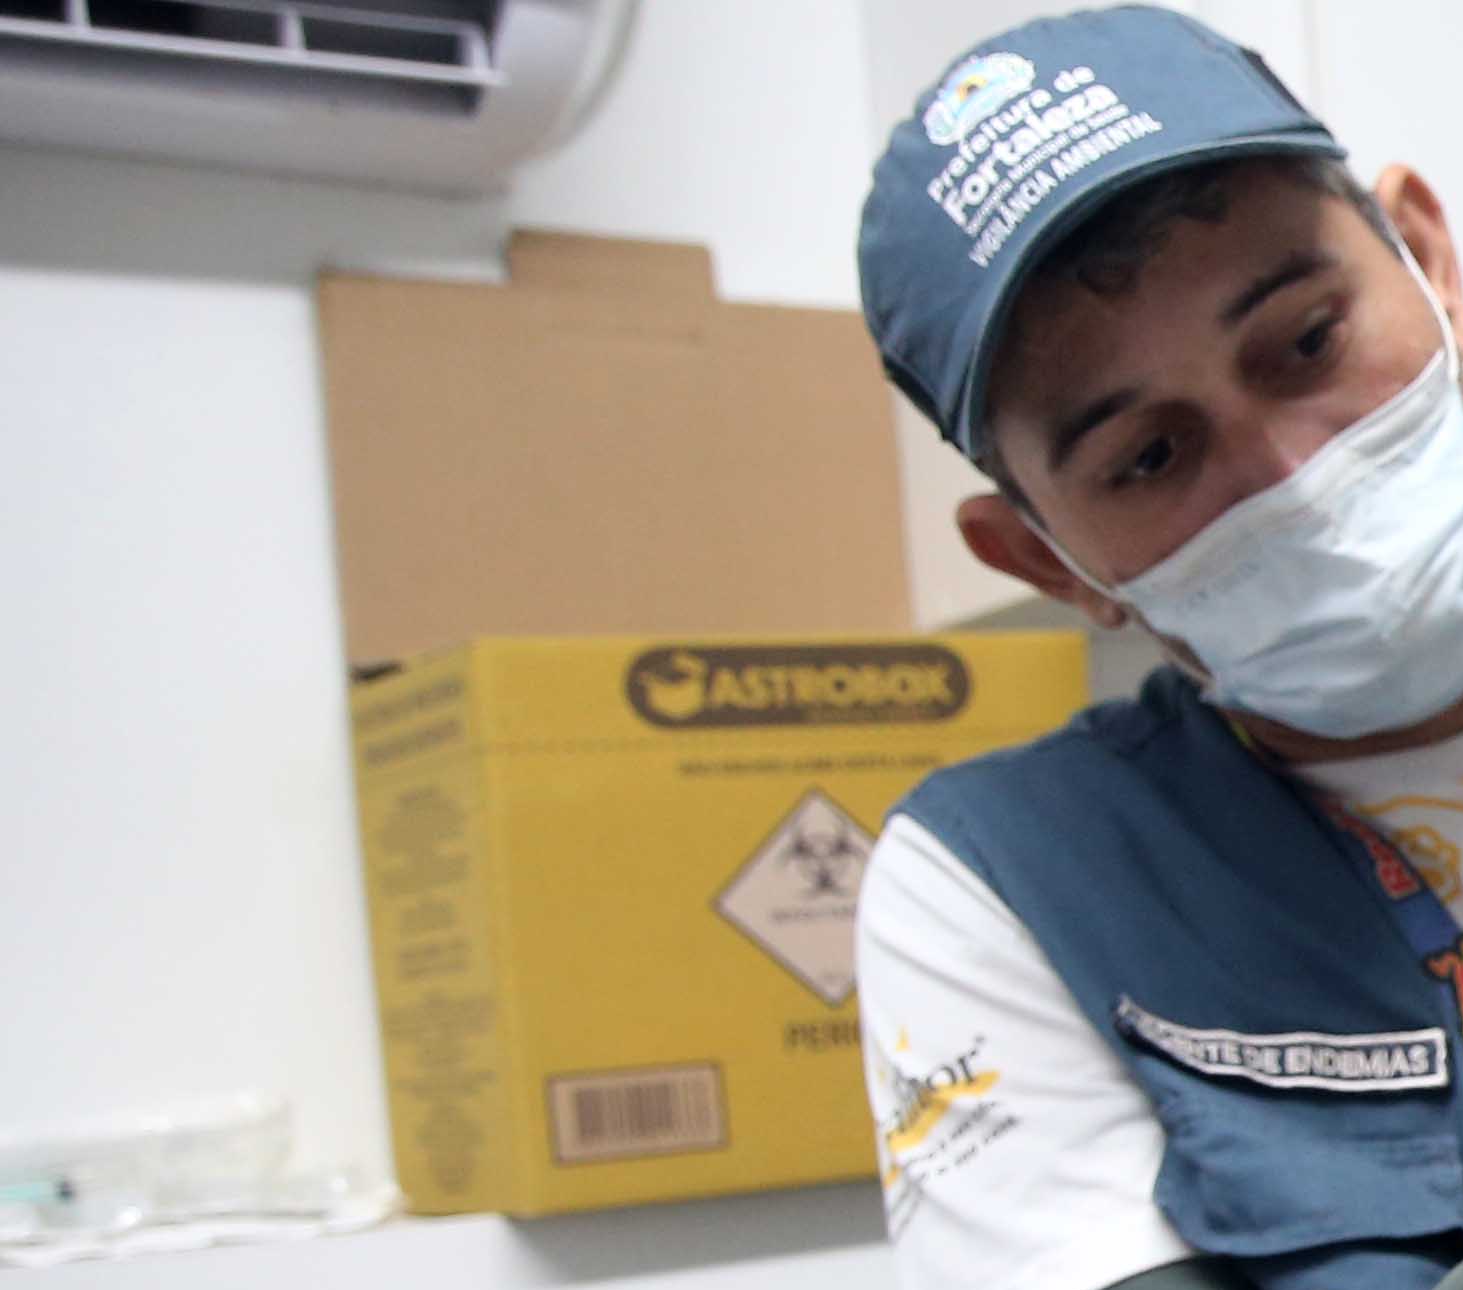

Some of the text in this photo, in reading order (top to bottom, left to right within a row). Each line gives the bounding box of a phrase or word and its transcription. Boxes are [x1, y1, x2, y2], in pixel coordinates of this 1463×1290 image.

[927, 88, 1053, 203] Prefeitura
[1053, 66, 1096, 93] de
[943, 84, 1120, 225] Fortaleza
[709, 662, 952, 710] ASTROBOX
[1284, 1041, 1430, 1079] ENDEMIAS
